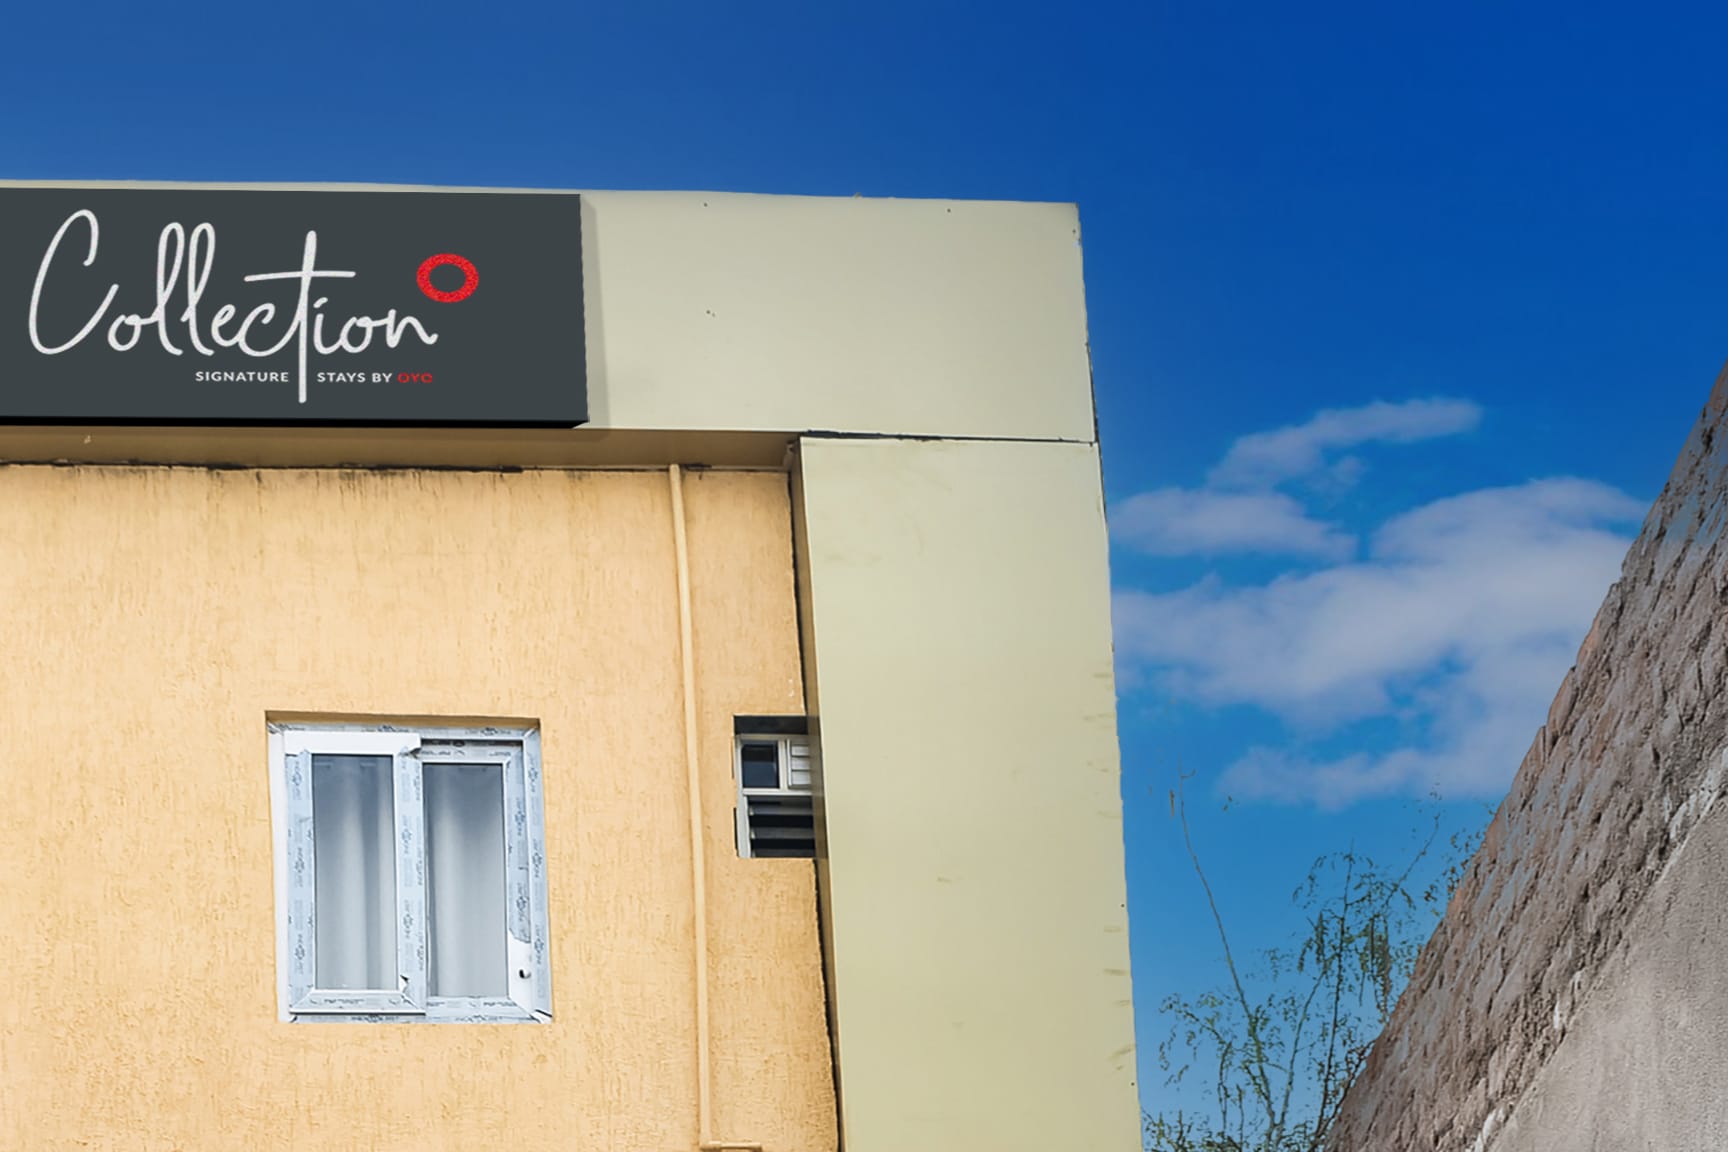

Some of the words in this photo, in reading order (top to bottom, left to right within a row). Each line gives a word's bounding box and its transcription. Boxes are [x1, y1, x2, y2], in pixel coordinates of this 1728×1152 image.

[28, 209, 439, 404] Collection
[194, 371, 290, 383] SIGNATURE
[317, 372, 367, 384] STAYS
[371, 372, 394, 384] BY
[397, 371, 434, 384] OYO
